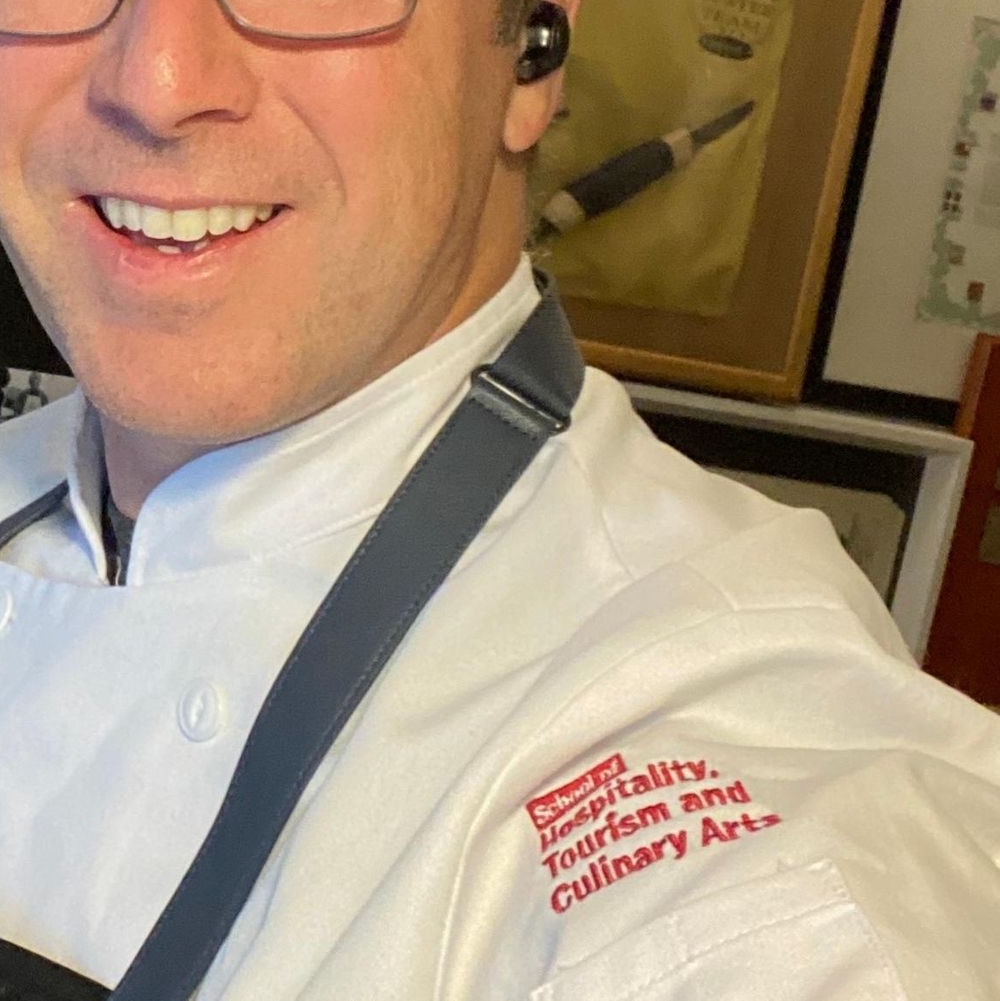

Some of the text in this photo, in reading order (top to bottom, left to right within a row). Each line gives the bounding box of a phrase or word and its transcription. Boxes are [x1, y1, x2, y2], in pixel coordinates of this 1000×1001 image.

[532, 756, 622, 828] School of
[541, 780, 753, 880] Tourism and
[550, 813, 783, 915] Culinary Arts
